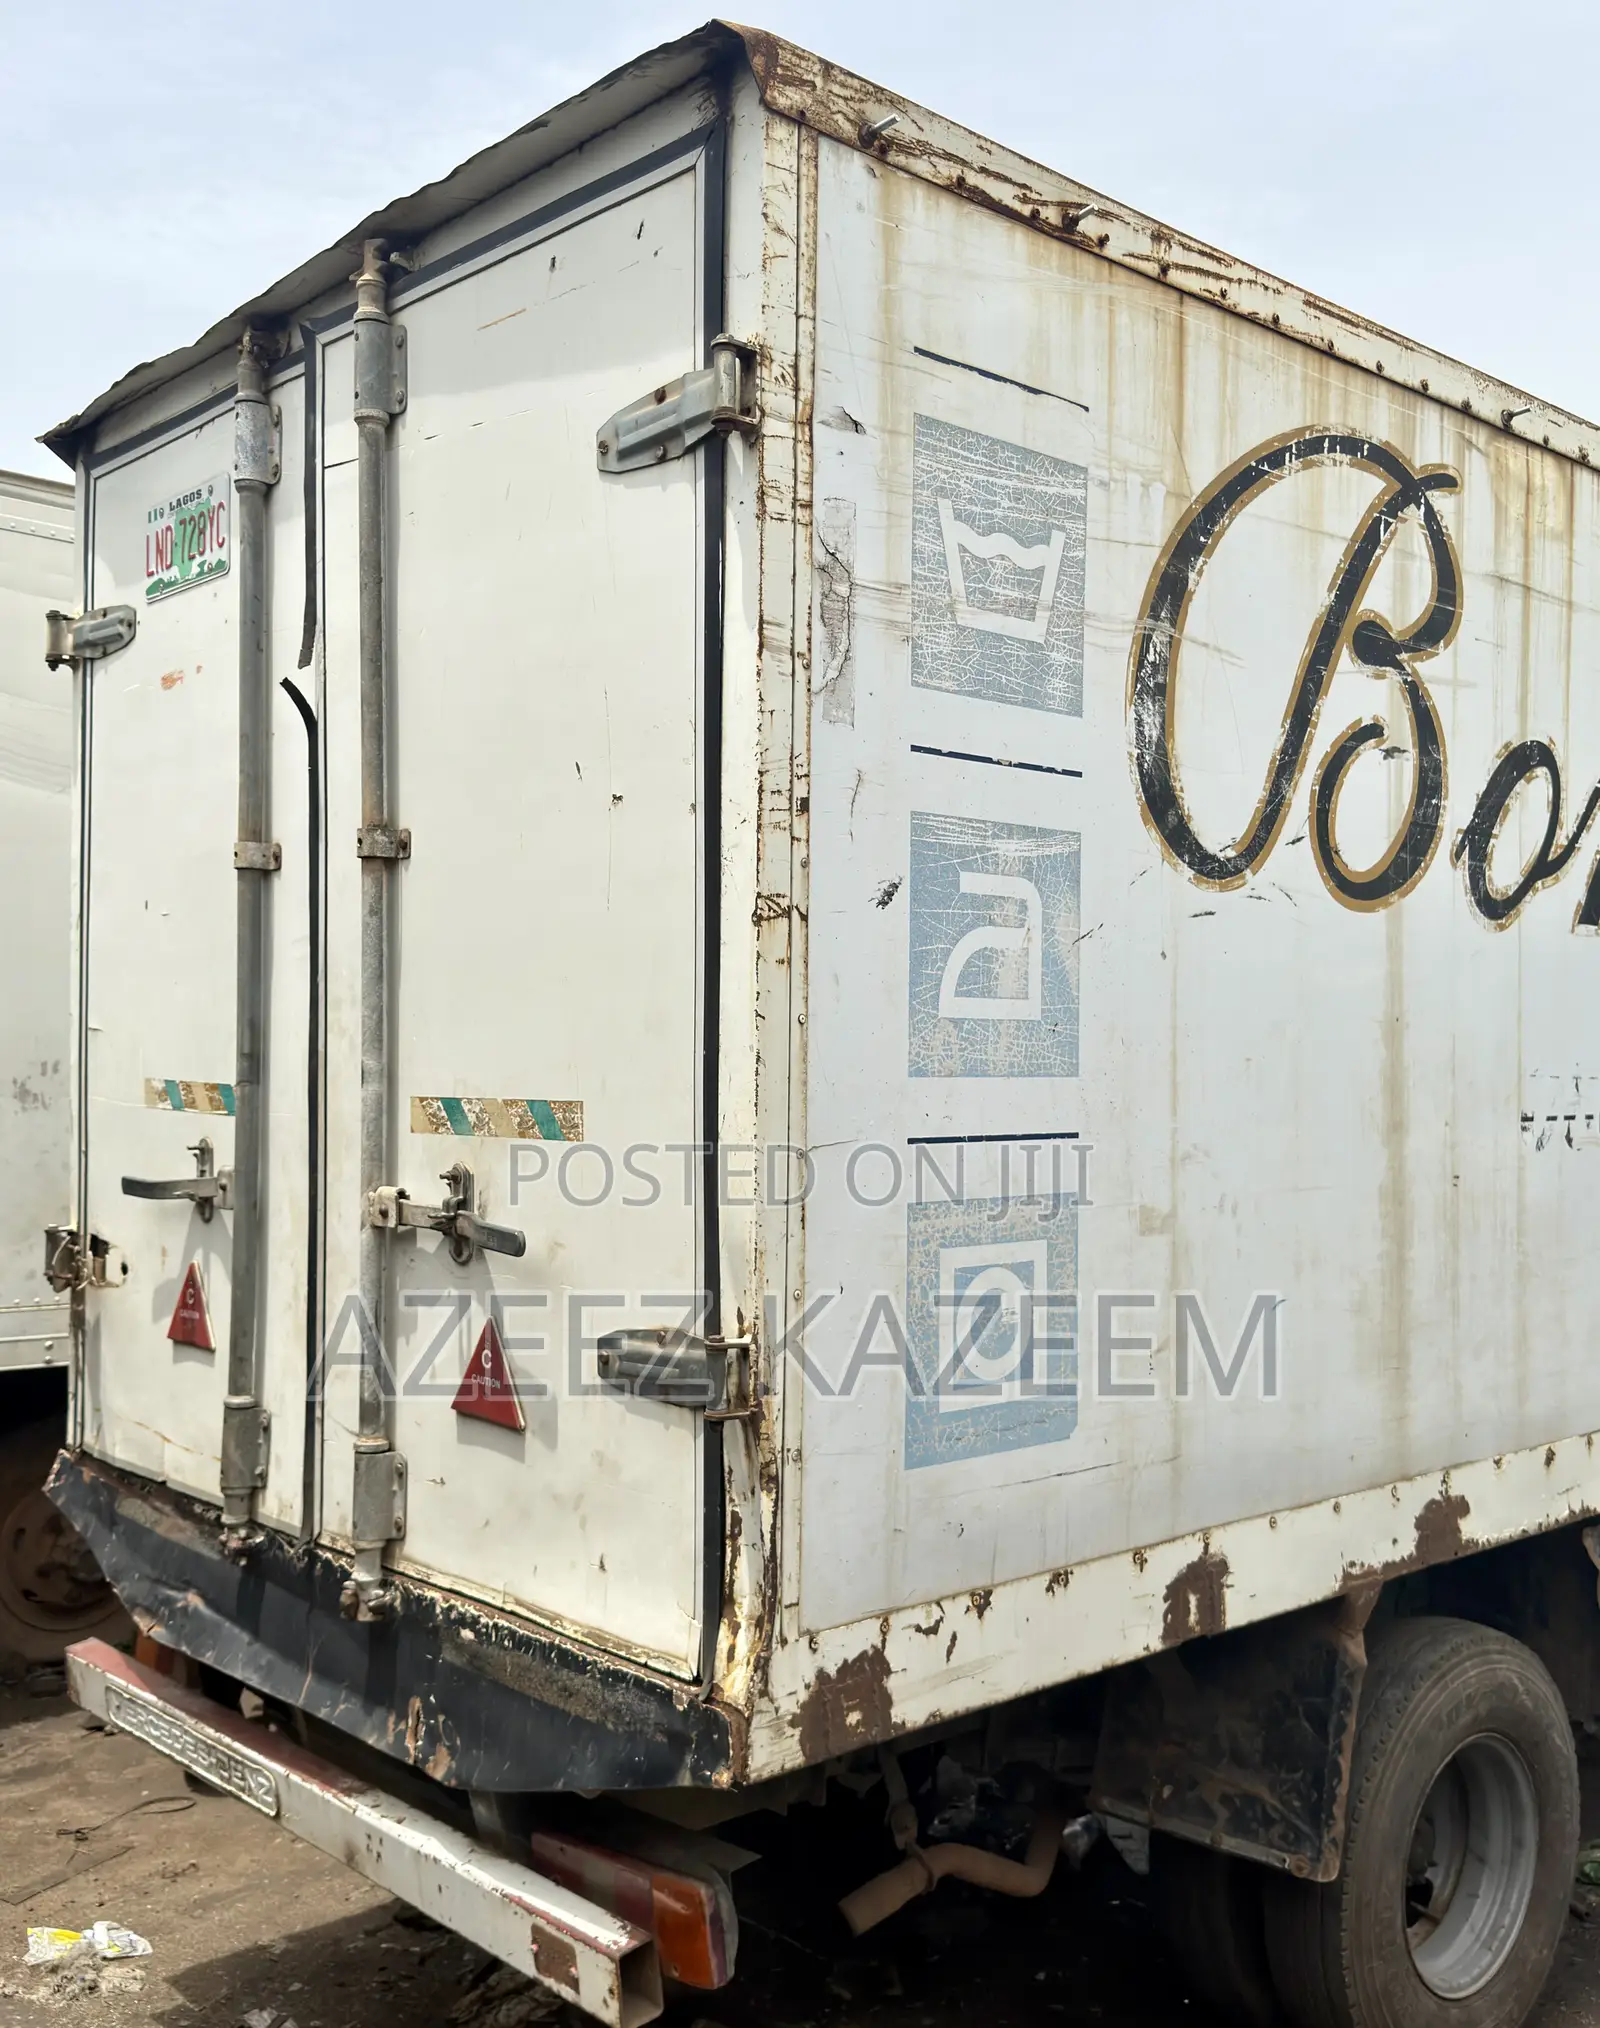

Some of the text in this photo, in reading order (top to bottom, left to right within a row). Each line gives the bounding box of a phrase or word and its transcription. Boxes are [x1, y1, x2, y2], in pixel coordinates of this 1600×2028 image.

[168, 488, 203, 512] LAGOS
[481, 1349, 492, 1369] C
[471, 1373, 500, 1389] CAUTION
